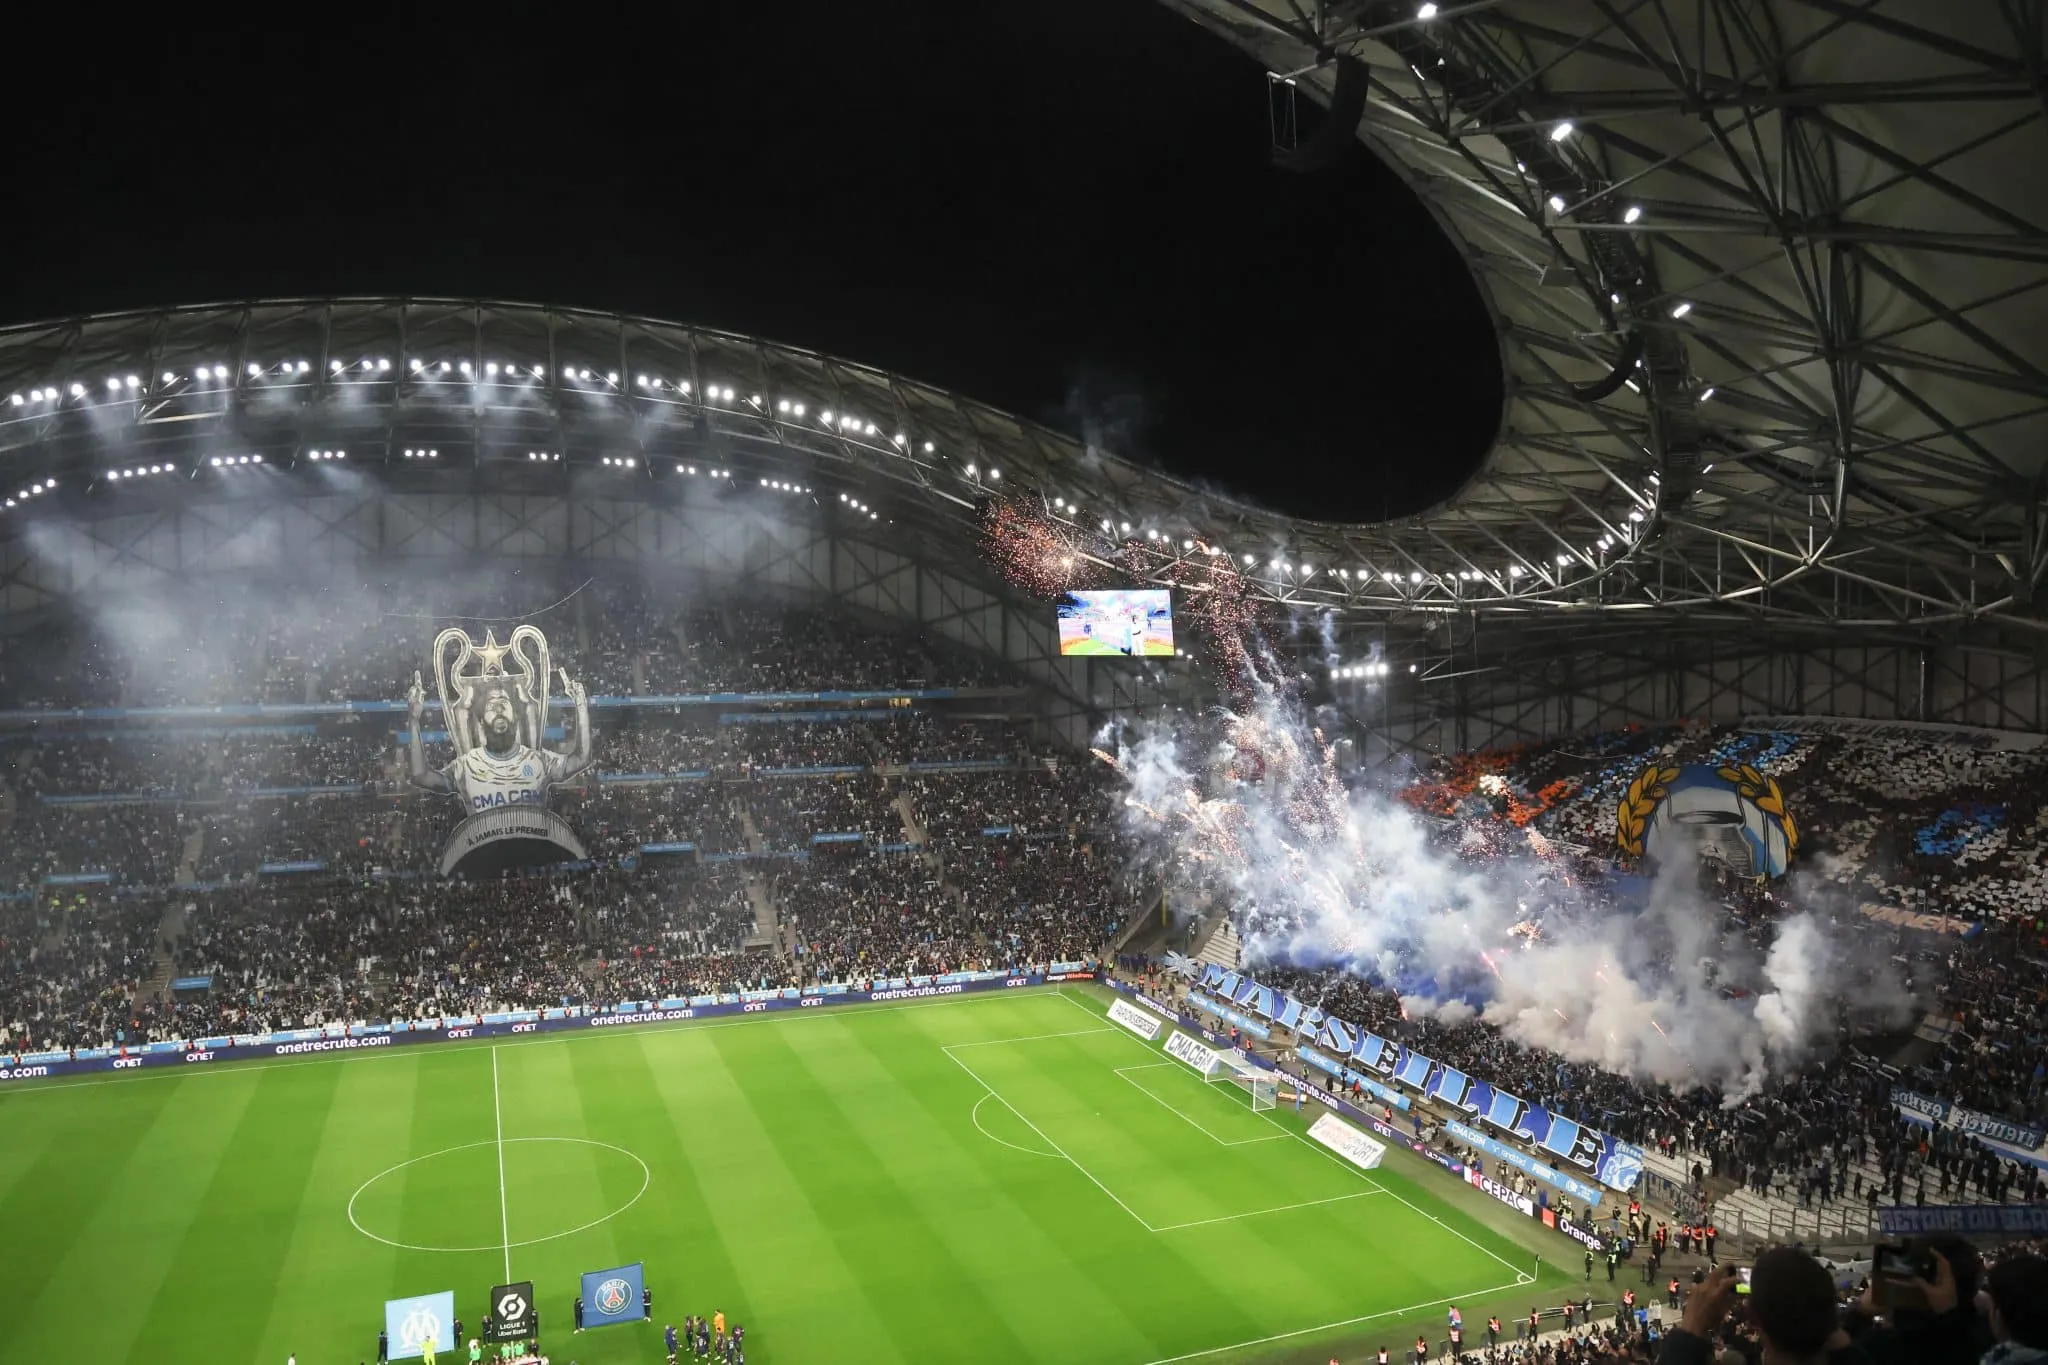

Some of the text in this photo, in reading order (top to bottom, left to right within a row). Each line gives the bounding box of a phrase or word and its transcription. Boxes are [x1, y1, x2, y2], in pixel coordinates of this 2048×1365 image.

[473, 791, 505, 809] CMA
[475, 828, 505, 842] JAMAIS
[504, 826, 516, 834] LE
[515, 826, 548, 837] PREMIER
[871, 983, 962, 1001] onetrecrute.com
[591, 1008, 694, 1026] onetrecrute.com
[275, 1034, 391, 1054] onetrecrute.com
[1196, 962, 1606, 1177] MARSEILLE
[1272, 1068, 1339, 1110] onetrecrute.com
[1482, 1176, 1526, 1212] CEPAC
[1879, 1208, 1964, 1233] RETOUR
[1559, 1218, 1601, 1251] Orange
[499, 1322, 521, 1330] LIGUE
